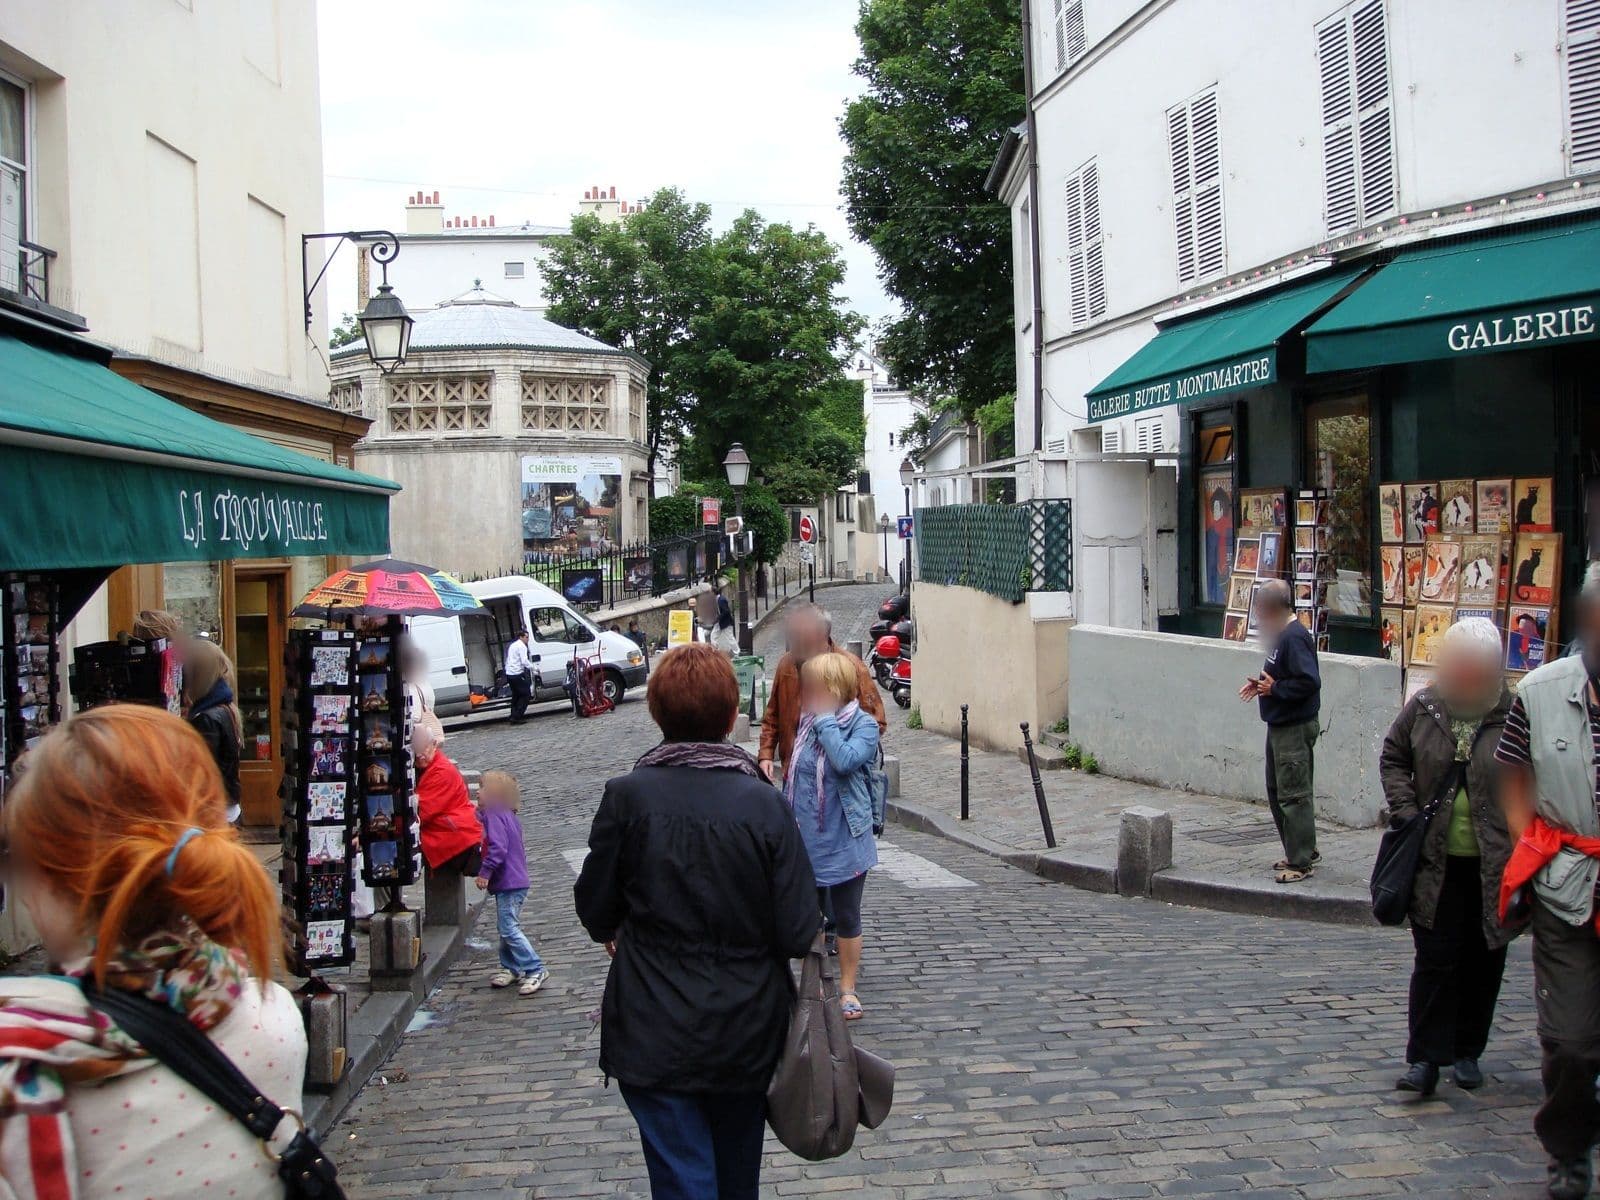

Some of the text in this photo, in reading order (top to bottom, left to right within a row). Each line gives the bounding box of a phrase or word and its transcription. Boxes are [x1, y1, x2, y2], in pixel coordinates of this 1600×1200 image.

[1447, 305, 1595, 351] GALERIE
[1089, 357, 1270, 419] GALERIE BUTTE MONTMARTRE
[528, 464, 578, 474] CHARTRES
[180, 488, 328, 551] LA TROUVAILLE
[316, 752, 341, 763] PARIS
